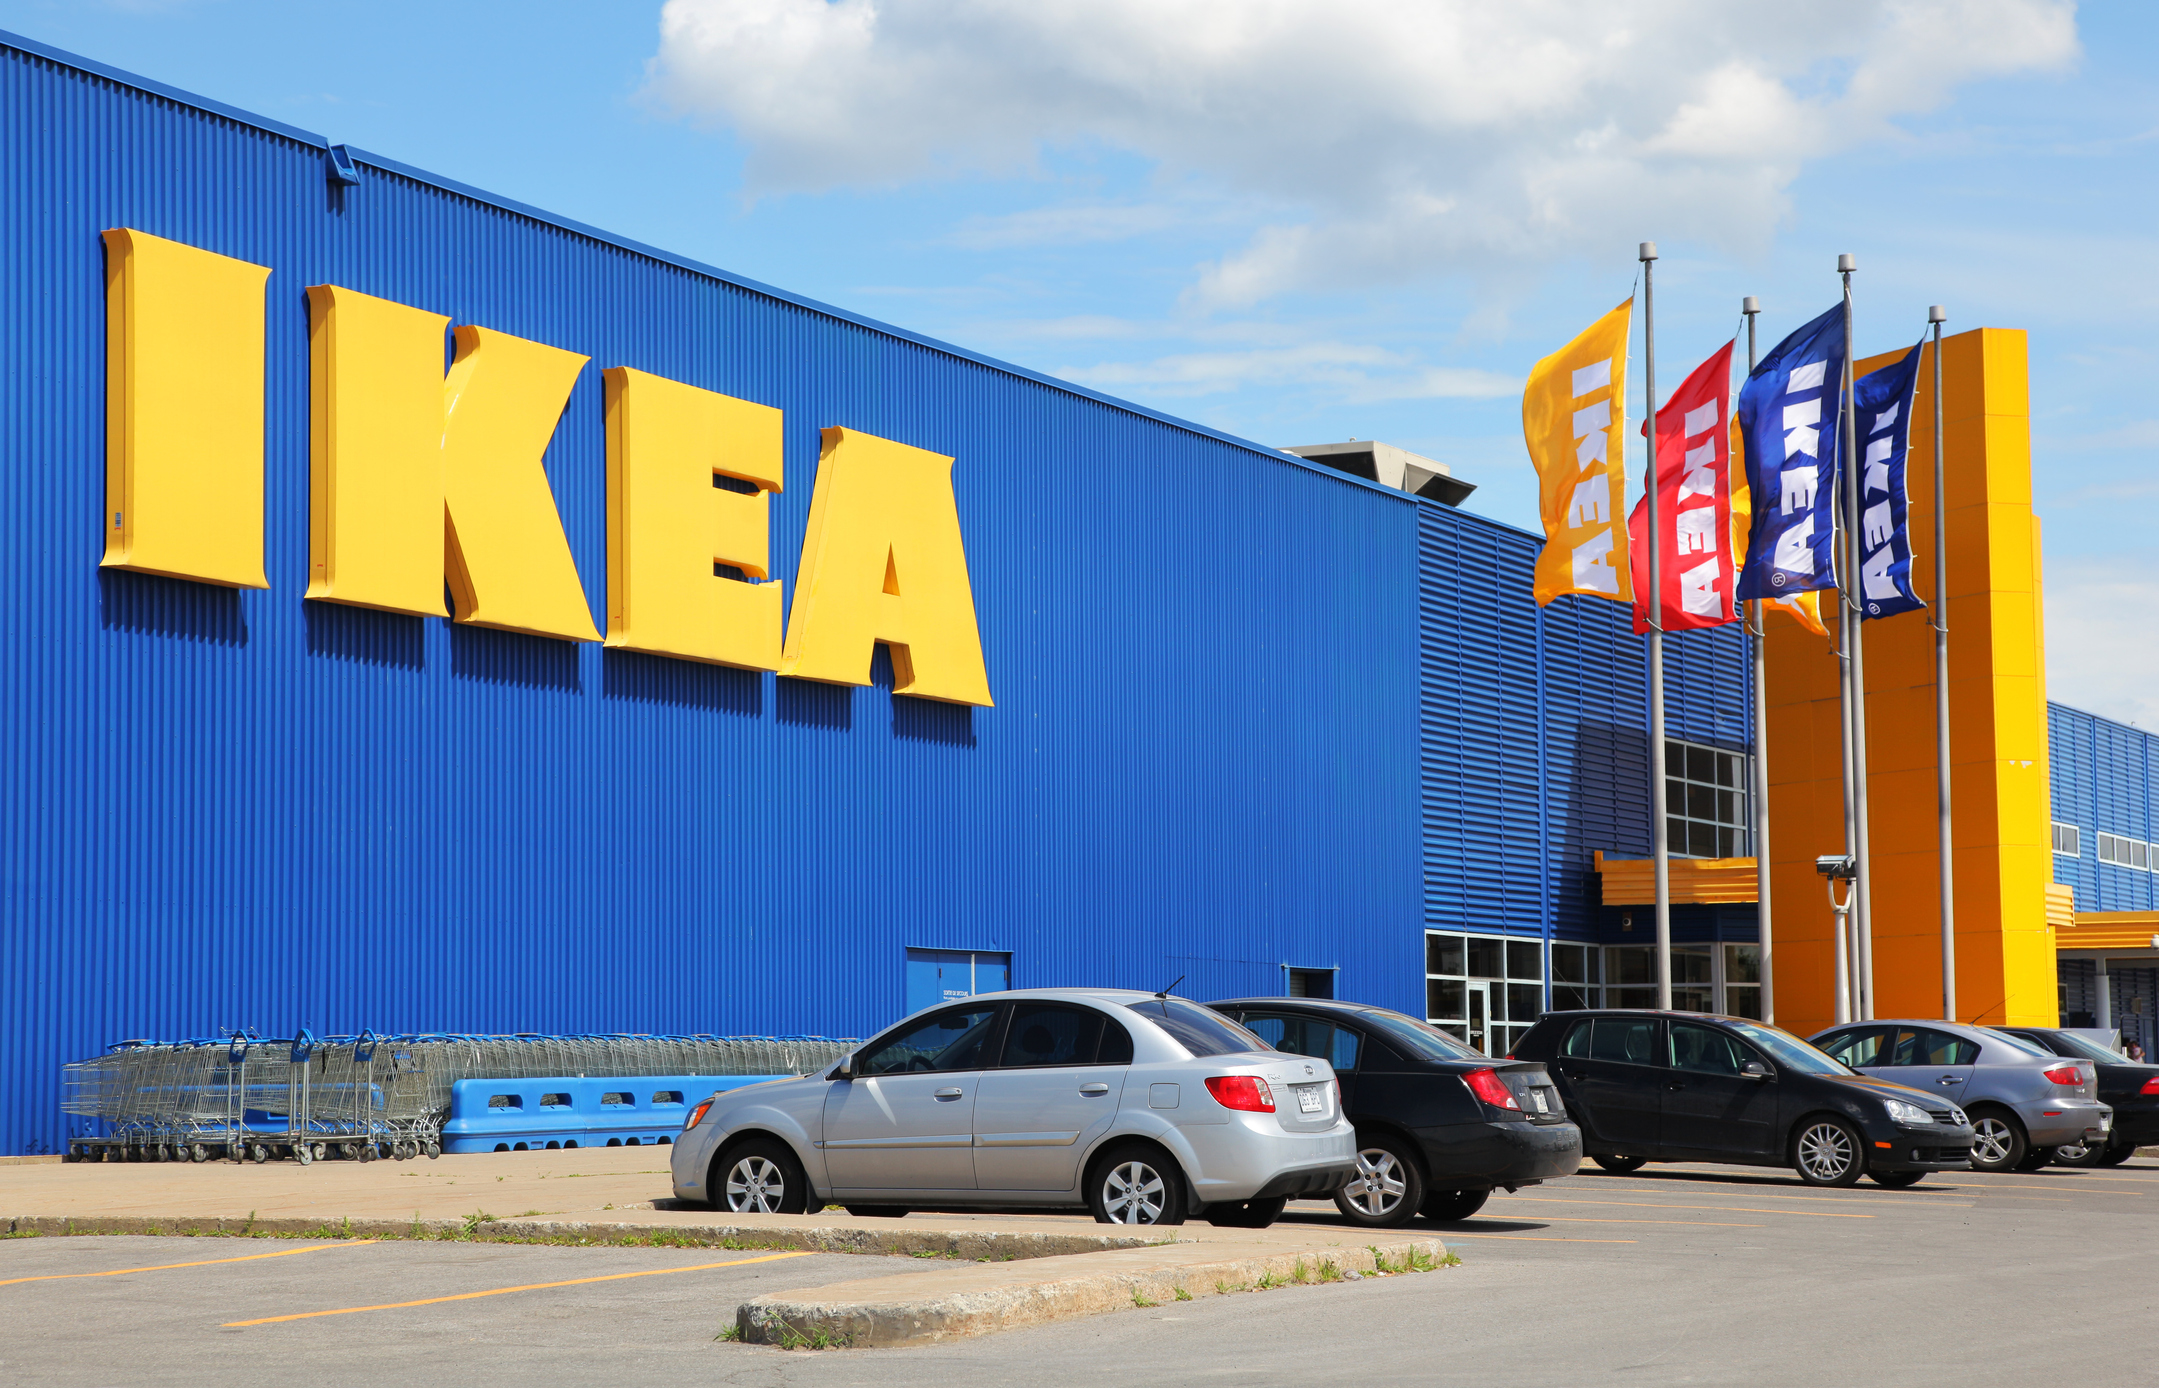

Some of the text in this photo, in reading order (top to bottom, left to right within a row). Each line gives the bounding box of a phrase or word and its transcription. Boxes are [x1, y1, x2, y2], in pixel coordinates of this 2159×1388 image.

[99, 228, 995, 707] IKEA
[1568, 357, 1619, 594] IKEA
[1677, 397, 1723, 619] IKEA
[1774, 359, 1828, 575] IKEA
[1862, 401, 1903, 600] IKEA
